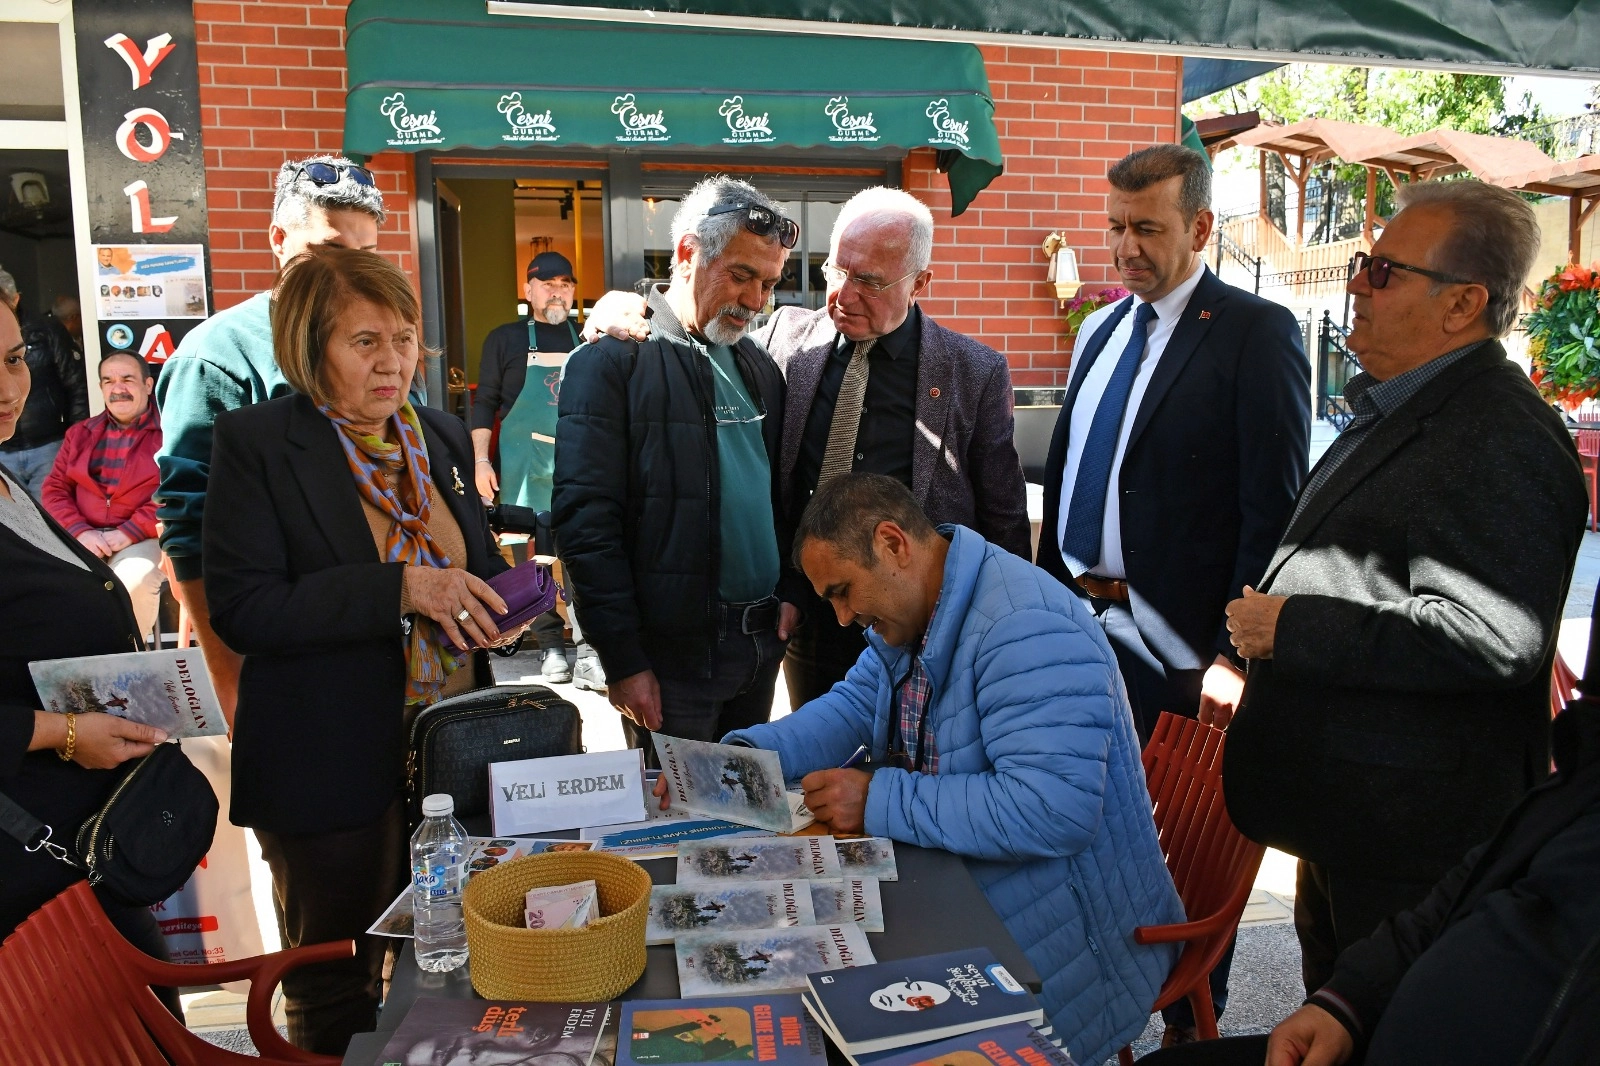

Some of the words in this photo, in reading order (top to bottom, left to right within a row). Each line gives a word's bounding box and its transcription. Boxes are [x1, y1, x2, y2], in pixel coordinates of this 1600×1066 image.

[176, 659, 208, 729] DELOĞLAN
[557, 774, 625, 796] ERDEM
[809, 838, 825, 875] DELOĞLAN
[783, 883, 798, 926] DELOĞLAN
[851, 880, 867, 922] DELOĞLAN
[528, 910, 545, 929] 20
[472, 1006, 505, 1033] düş
[495, 1006, 527, 1038] terli
[561, 1008, 583, 1039] ERDEM
[579, 1008, 597, 1028] VELİ
[753, 1004, 774, 1034] GELME
[780, 1015, 802, 1046] DÜNLE
[756, 1034, 778, 1061] BANA
[807, 1025, 822, 1056] ERDEM
[1027, 1031, 1054, 1051] VELİ
